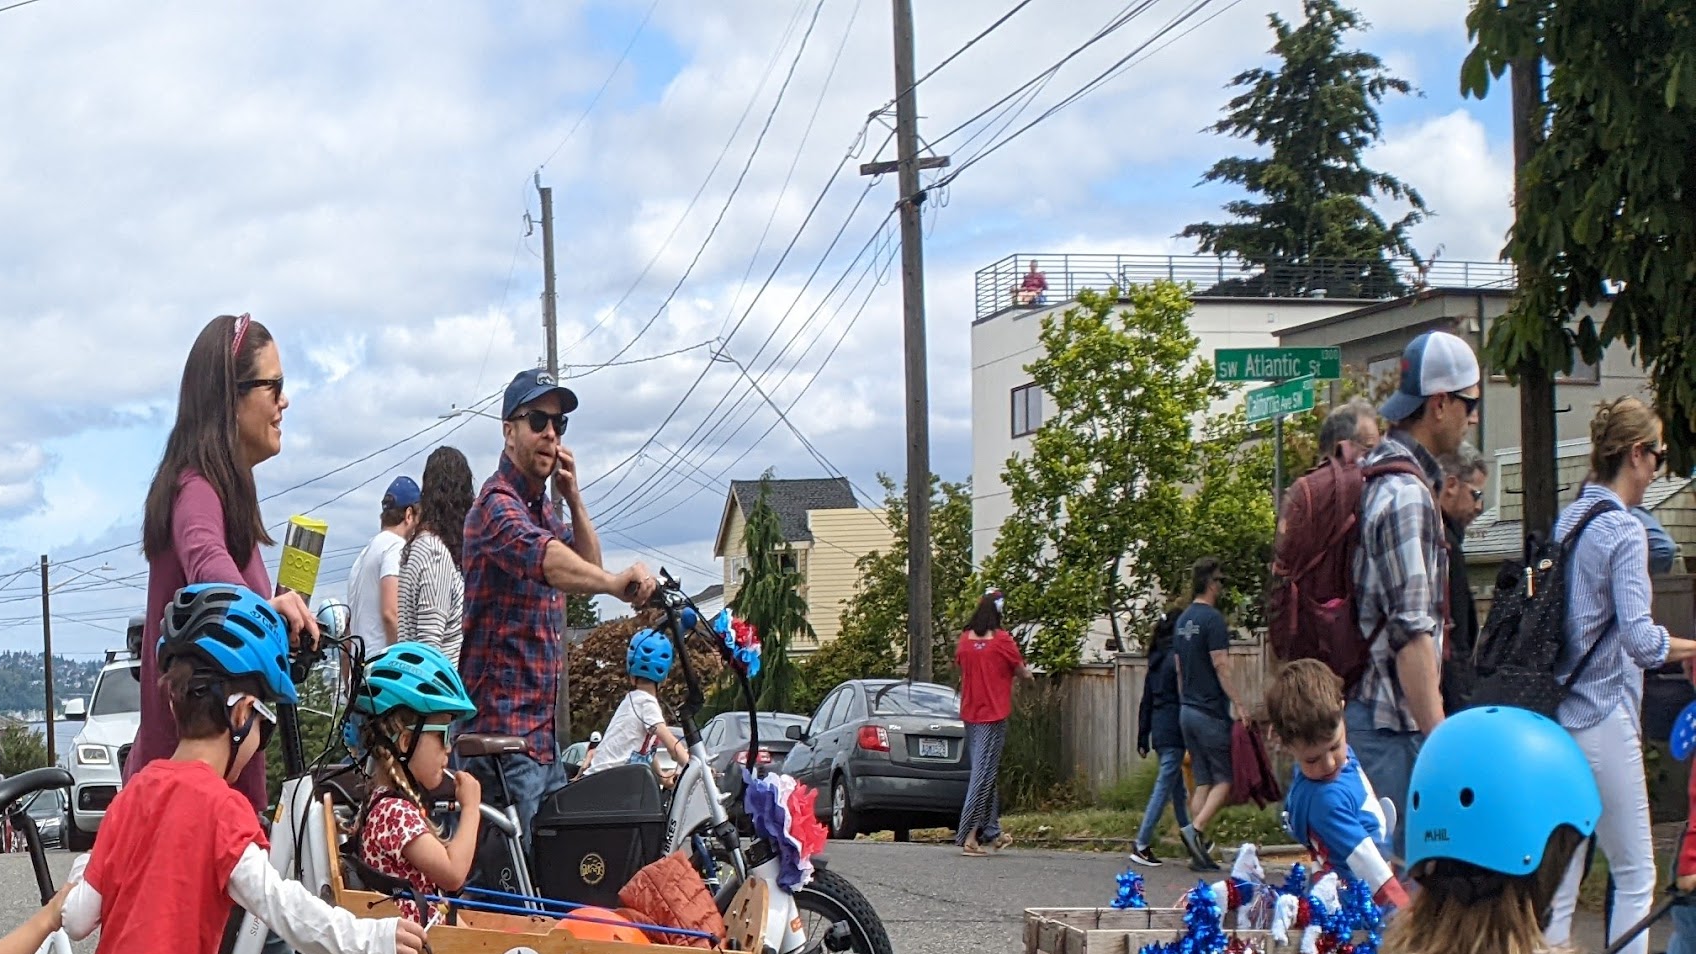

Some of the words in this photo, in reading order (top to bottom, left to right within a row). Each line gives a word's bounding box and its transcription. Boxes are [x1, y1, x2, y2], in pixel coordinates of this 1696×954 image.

[1219, 361, 1239, 378] SW
[1245, 353, 1301, 377] Atlantic
[1308, 360, 1322, 376] St
[664, 818, 677, 853] BIKES
